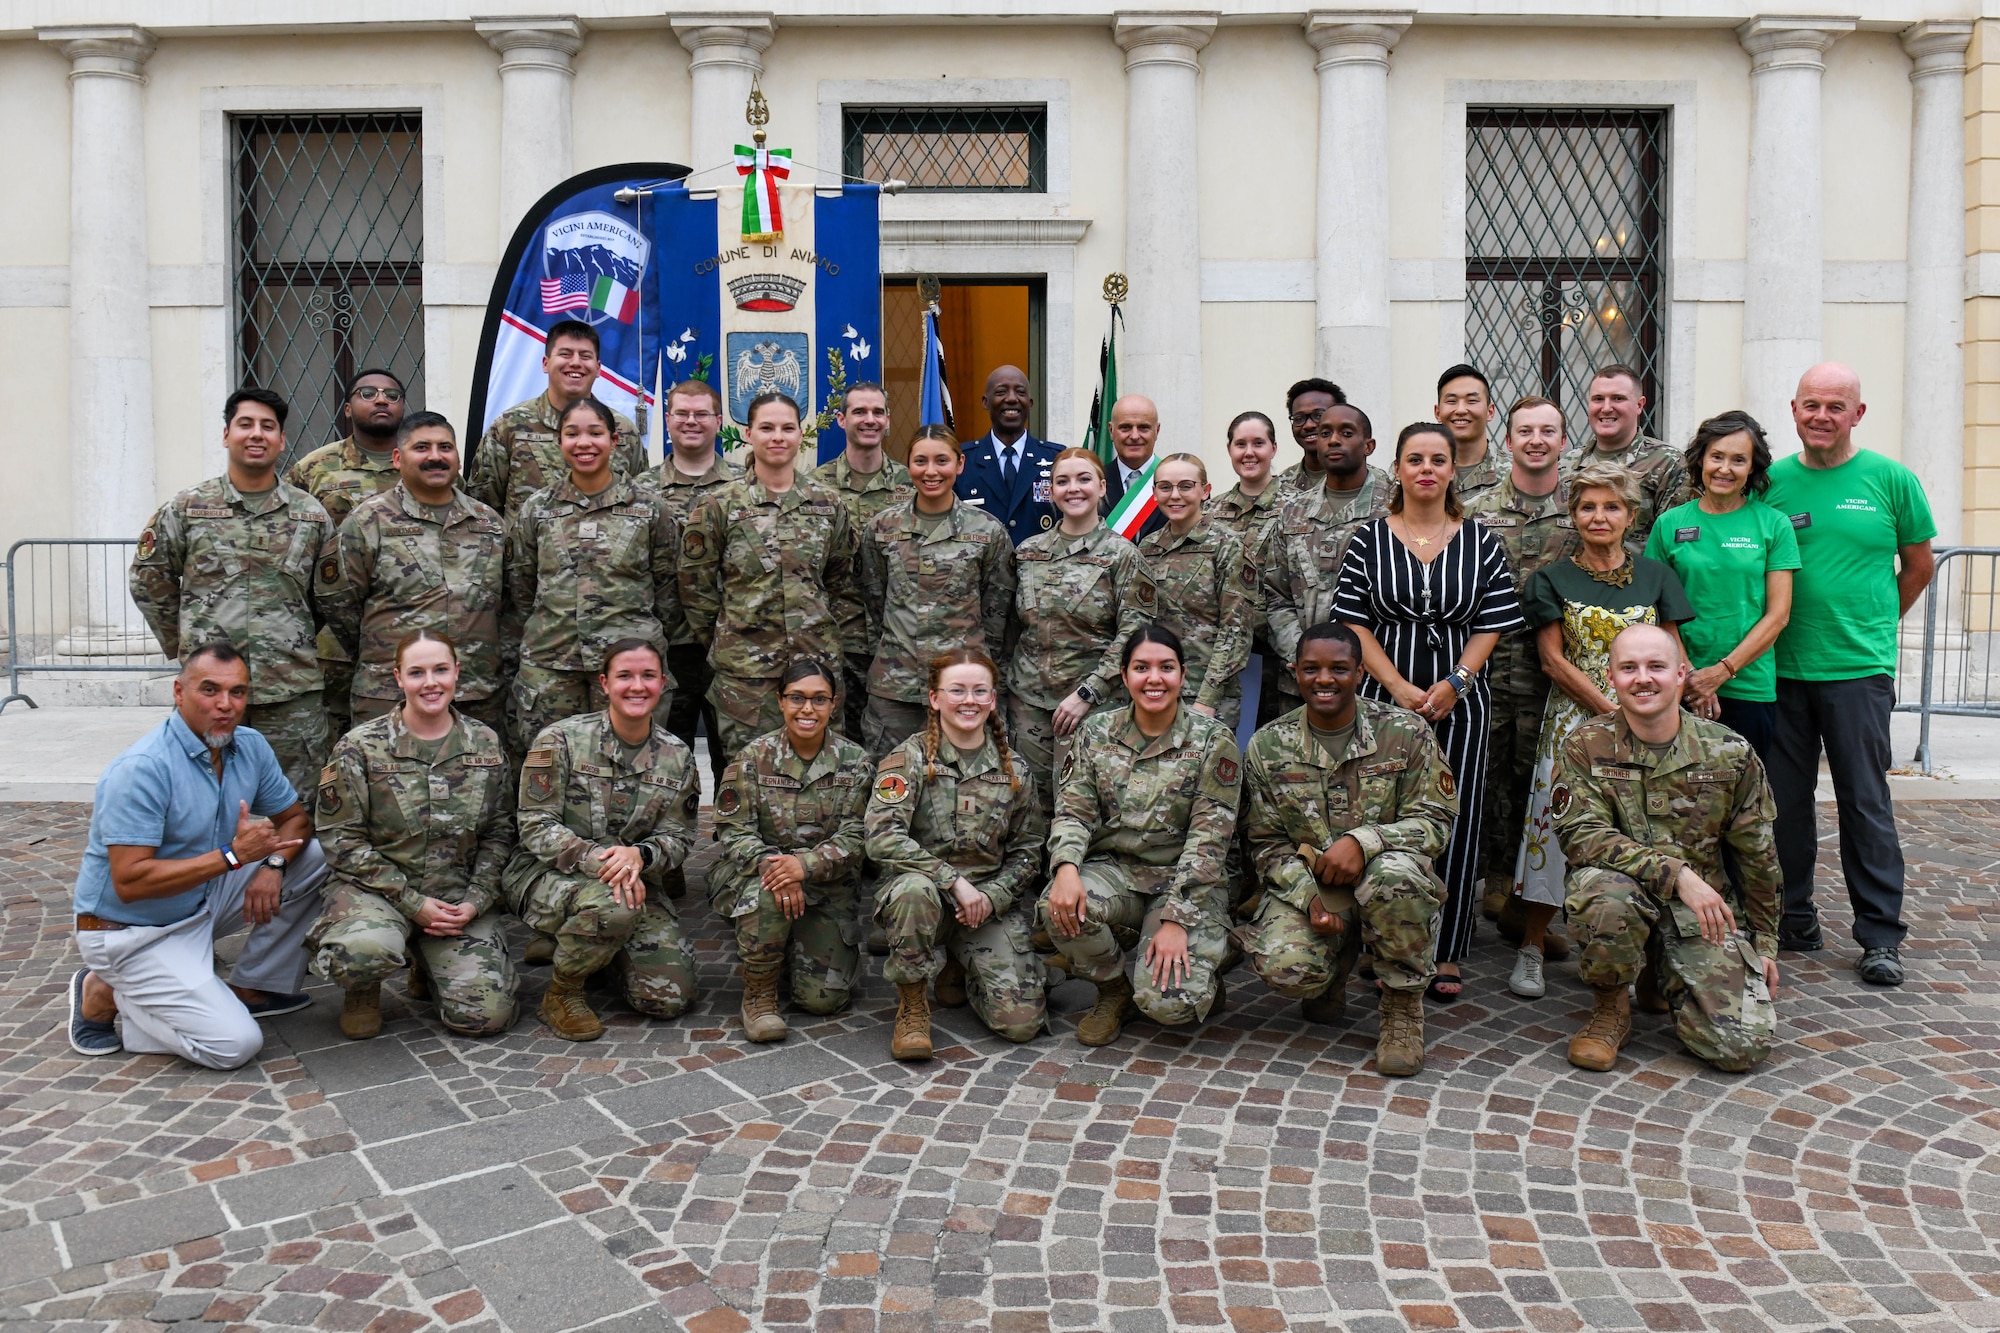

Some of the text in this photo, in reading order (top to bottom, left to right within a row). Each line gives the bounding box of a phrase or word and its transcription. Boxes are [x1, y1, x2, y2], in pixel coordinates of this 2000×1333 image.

[552, 221, 643, 249] VICINI AMERICANI
[694, 245, 841, 276] COMUNE DI AVIANO
[1835, 504, 1877, 512] AMERICANI
[191, 509, 228, 517] RODRIGUEZ
[973, 534, 989, 542] FORCE
[484, 756, 500, 764] FORCE
[1184, 751, 1201, 760] FORCE
[1385, 761, 1404, 771] FORCE
[1713, 770, 1734, 780] FORCE
[656, 776, 664, 784] AIR
[665, 778, 680, 788] FORCE
[762, 776, 796, 786] HERNANDEZ
[834, 776, 852, 785] FORCE
